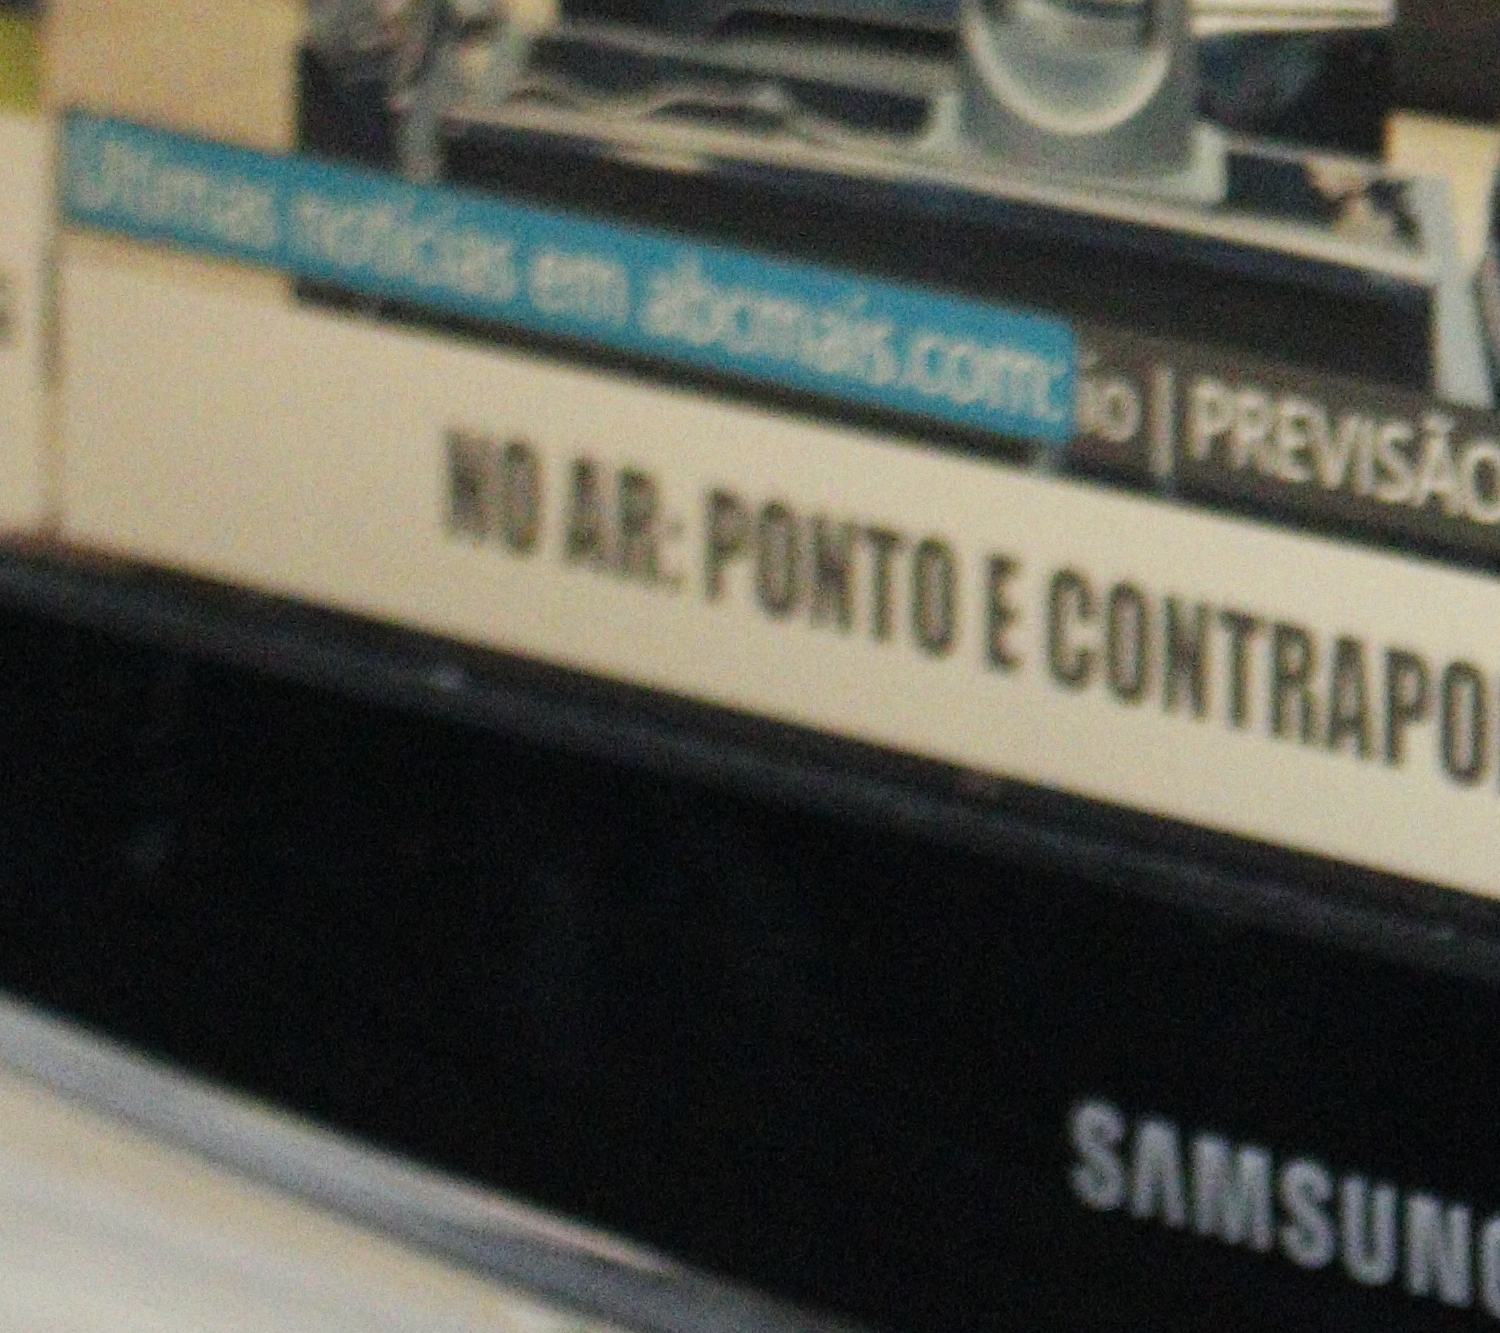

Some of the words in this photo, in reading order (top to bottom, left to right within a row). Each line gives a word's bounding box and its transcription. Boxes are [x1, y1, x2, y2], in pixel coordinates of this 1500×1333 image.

[527, 247, 628, 327] em
[444, 427, 542, 555] NO
[705, 485, 956, 657] PONTO
[984, 551, 1020, 671] E
